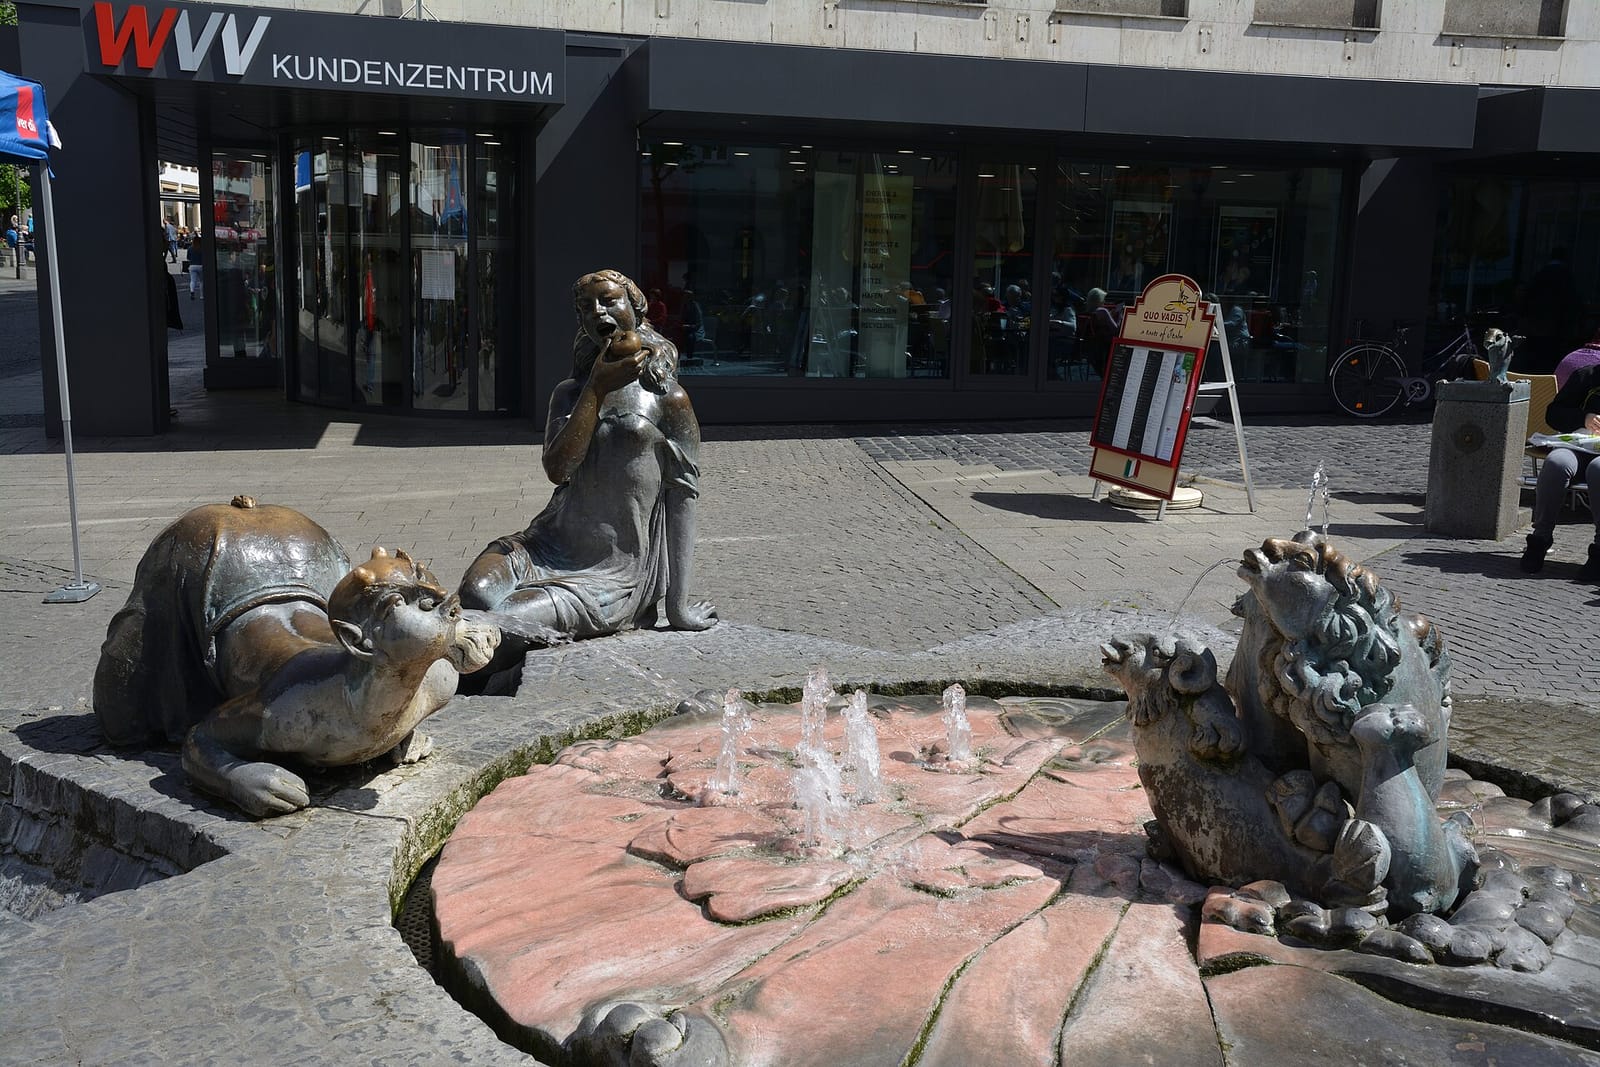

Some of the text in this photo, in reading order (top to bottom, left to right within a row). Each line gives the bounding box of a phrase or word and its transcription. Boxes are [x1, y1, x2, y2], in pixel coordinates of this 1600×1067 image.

[94, 2, 553, 96] WVV KUNDENZENTRUM
[1143, 311, 1183, 322] QUO VADIS
